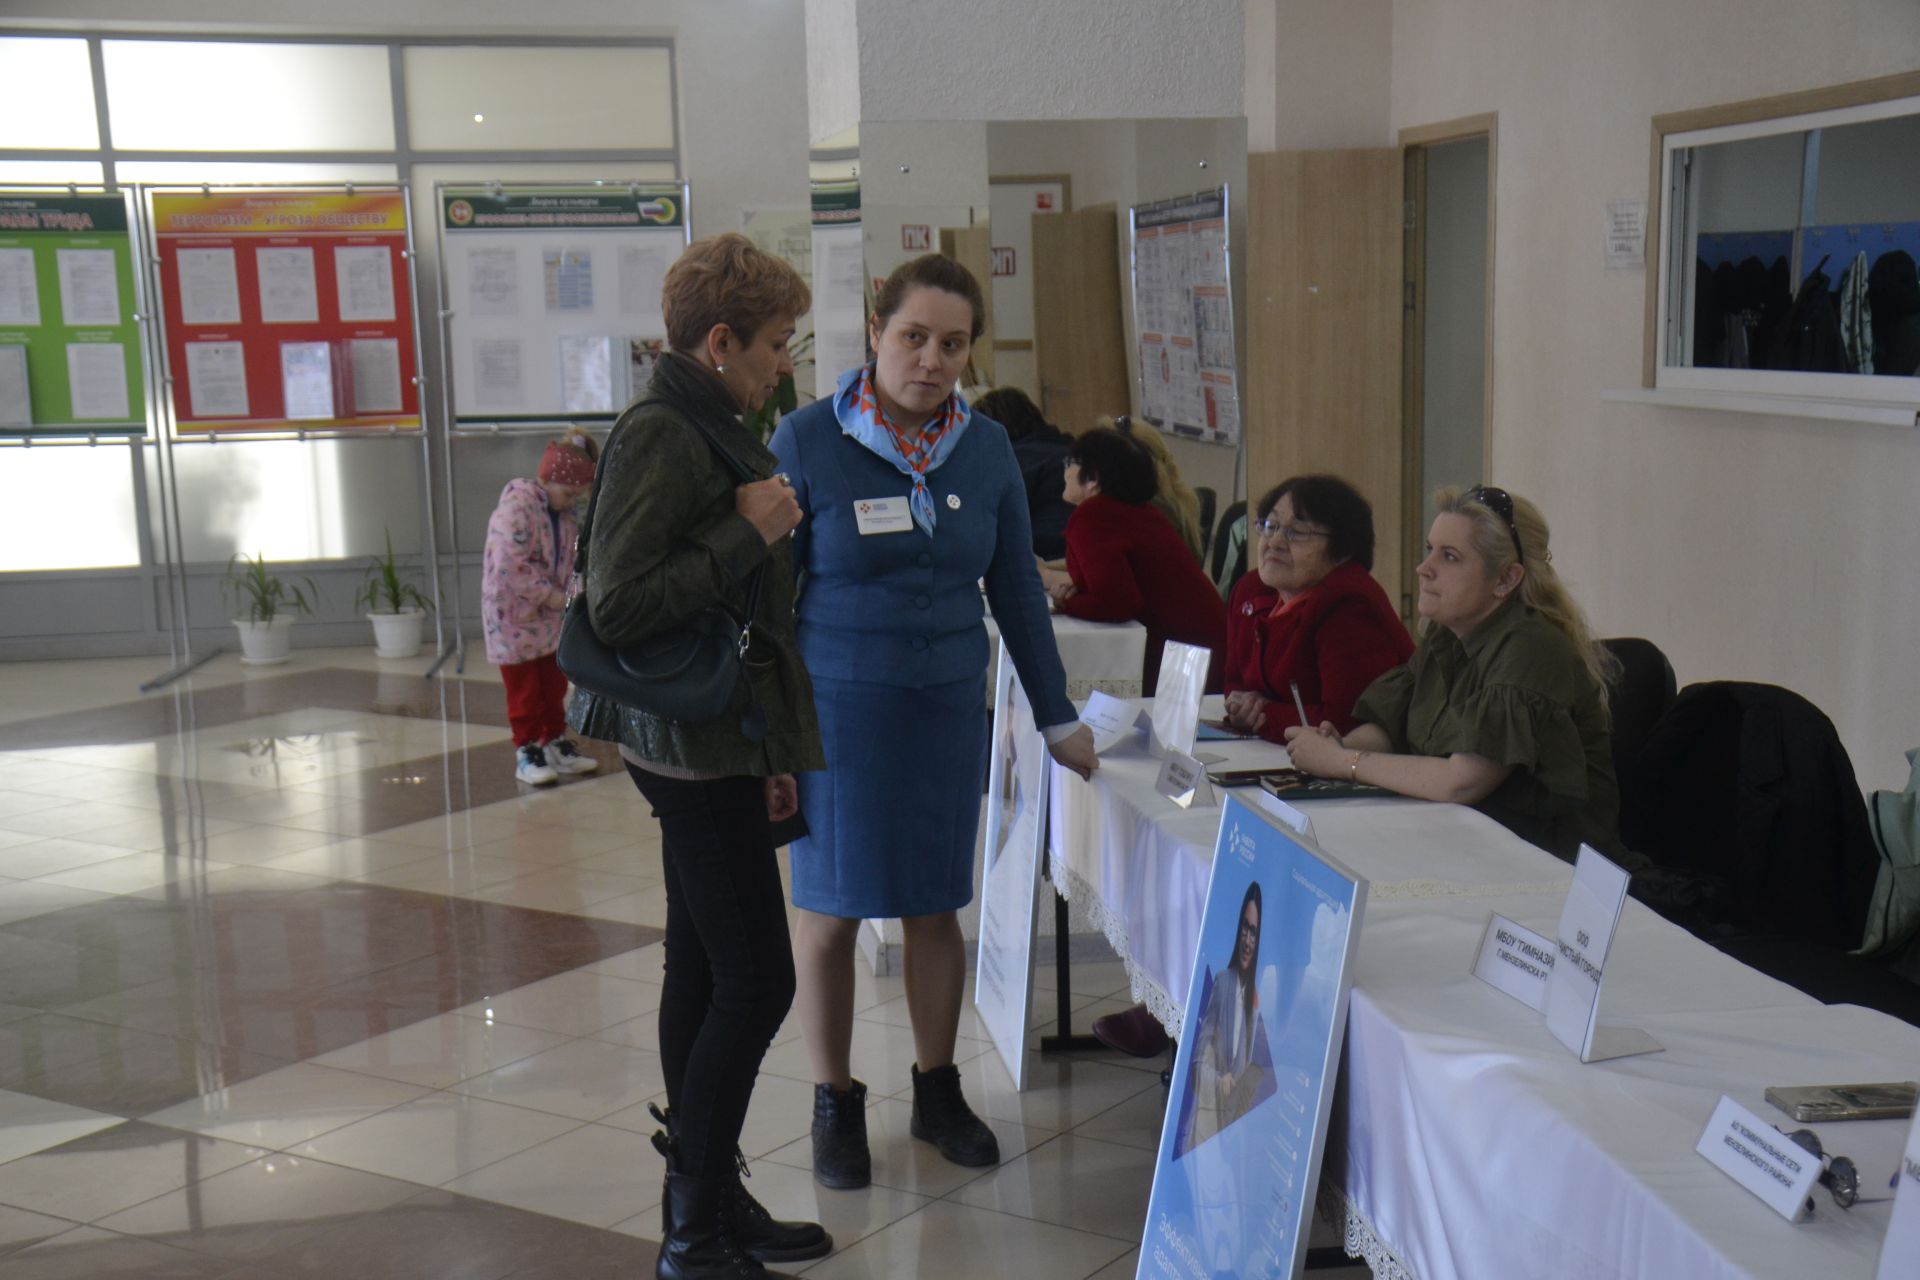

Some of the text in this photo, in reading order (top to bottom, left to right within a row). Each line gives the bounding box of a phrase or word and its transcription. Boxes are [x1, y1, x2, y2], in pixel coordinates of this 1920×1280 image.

[40, 212, 95, 231] ТРУДА
[171, 213, 252, 227] ТЕРРОРИЗМ
[264, 213, 312, 225] УГРОЗА
[318, 212, 388, 226] ОБЩЕСТВУ
[1495, 928, 1516, 948] МБОУ
